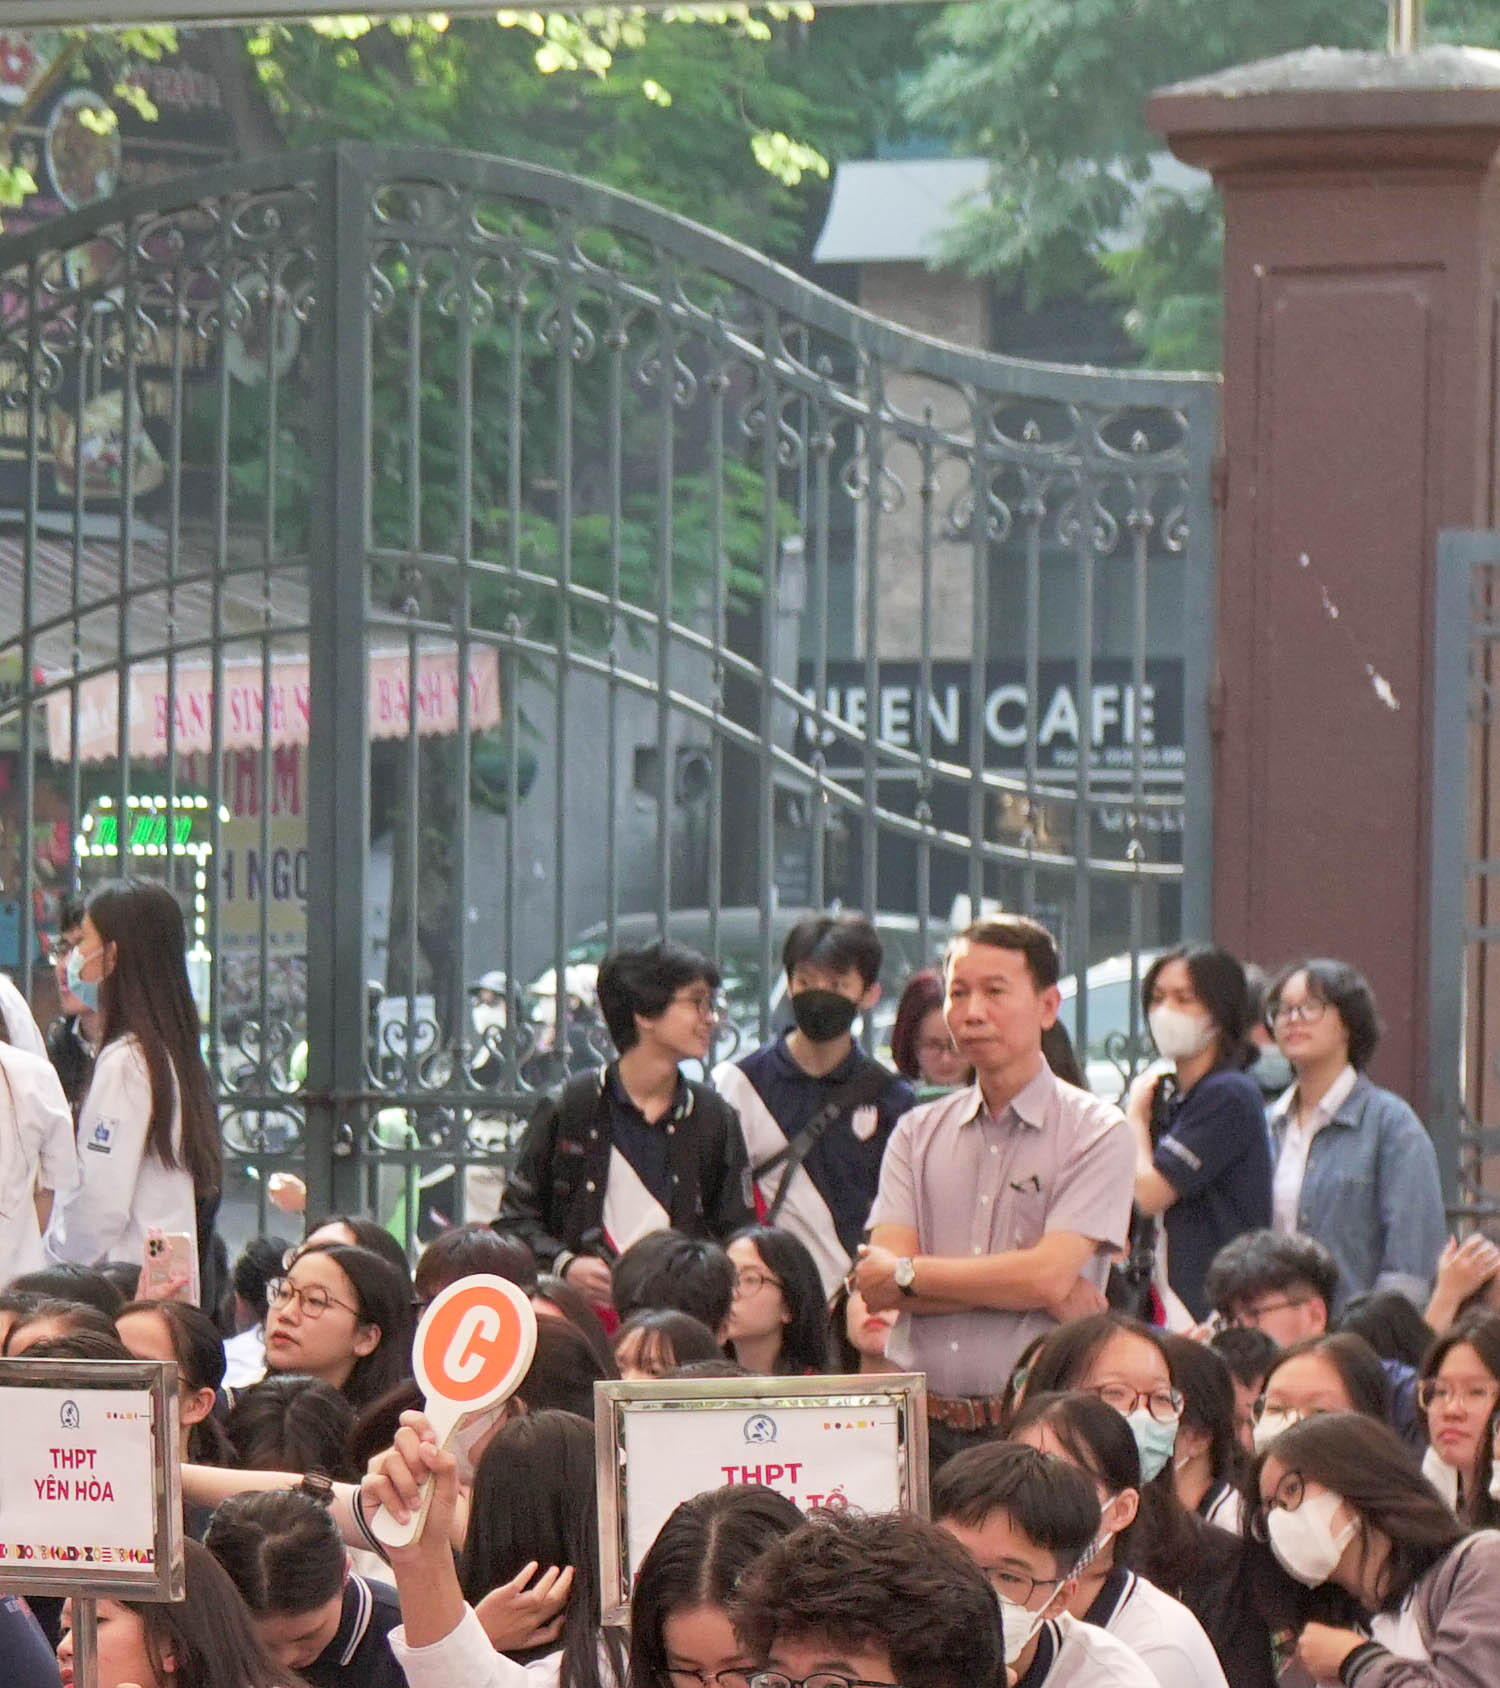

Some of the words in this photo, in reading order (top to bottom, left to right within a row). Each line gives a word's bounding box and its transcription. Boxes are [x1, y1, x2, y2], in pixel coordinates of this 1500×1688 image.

[986, 686, 1155, 746] CAFE
[443, 1305, 500, 1383] C
[49, 1448, 97, 1469] THPT
[34, 1474, 69, 1500] YÊN
[75, 1476, 114, 1502] HÒA
[721, 1463, 803, 1486] THPT
